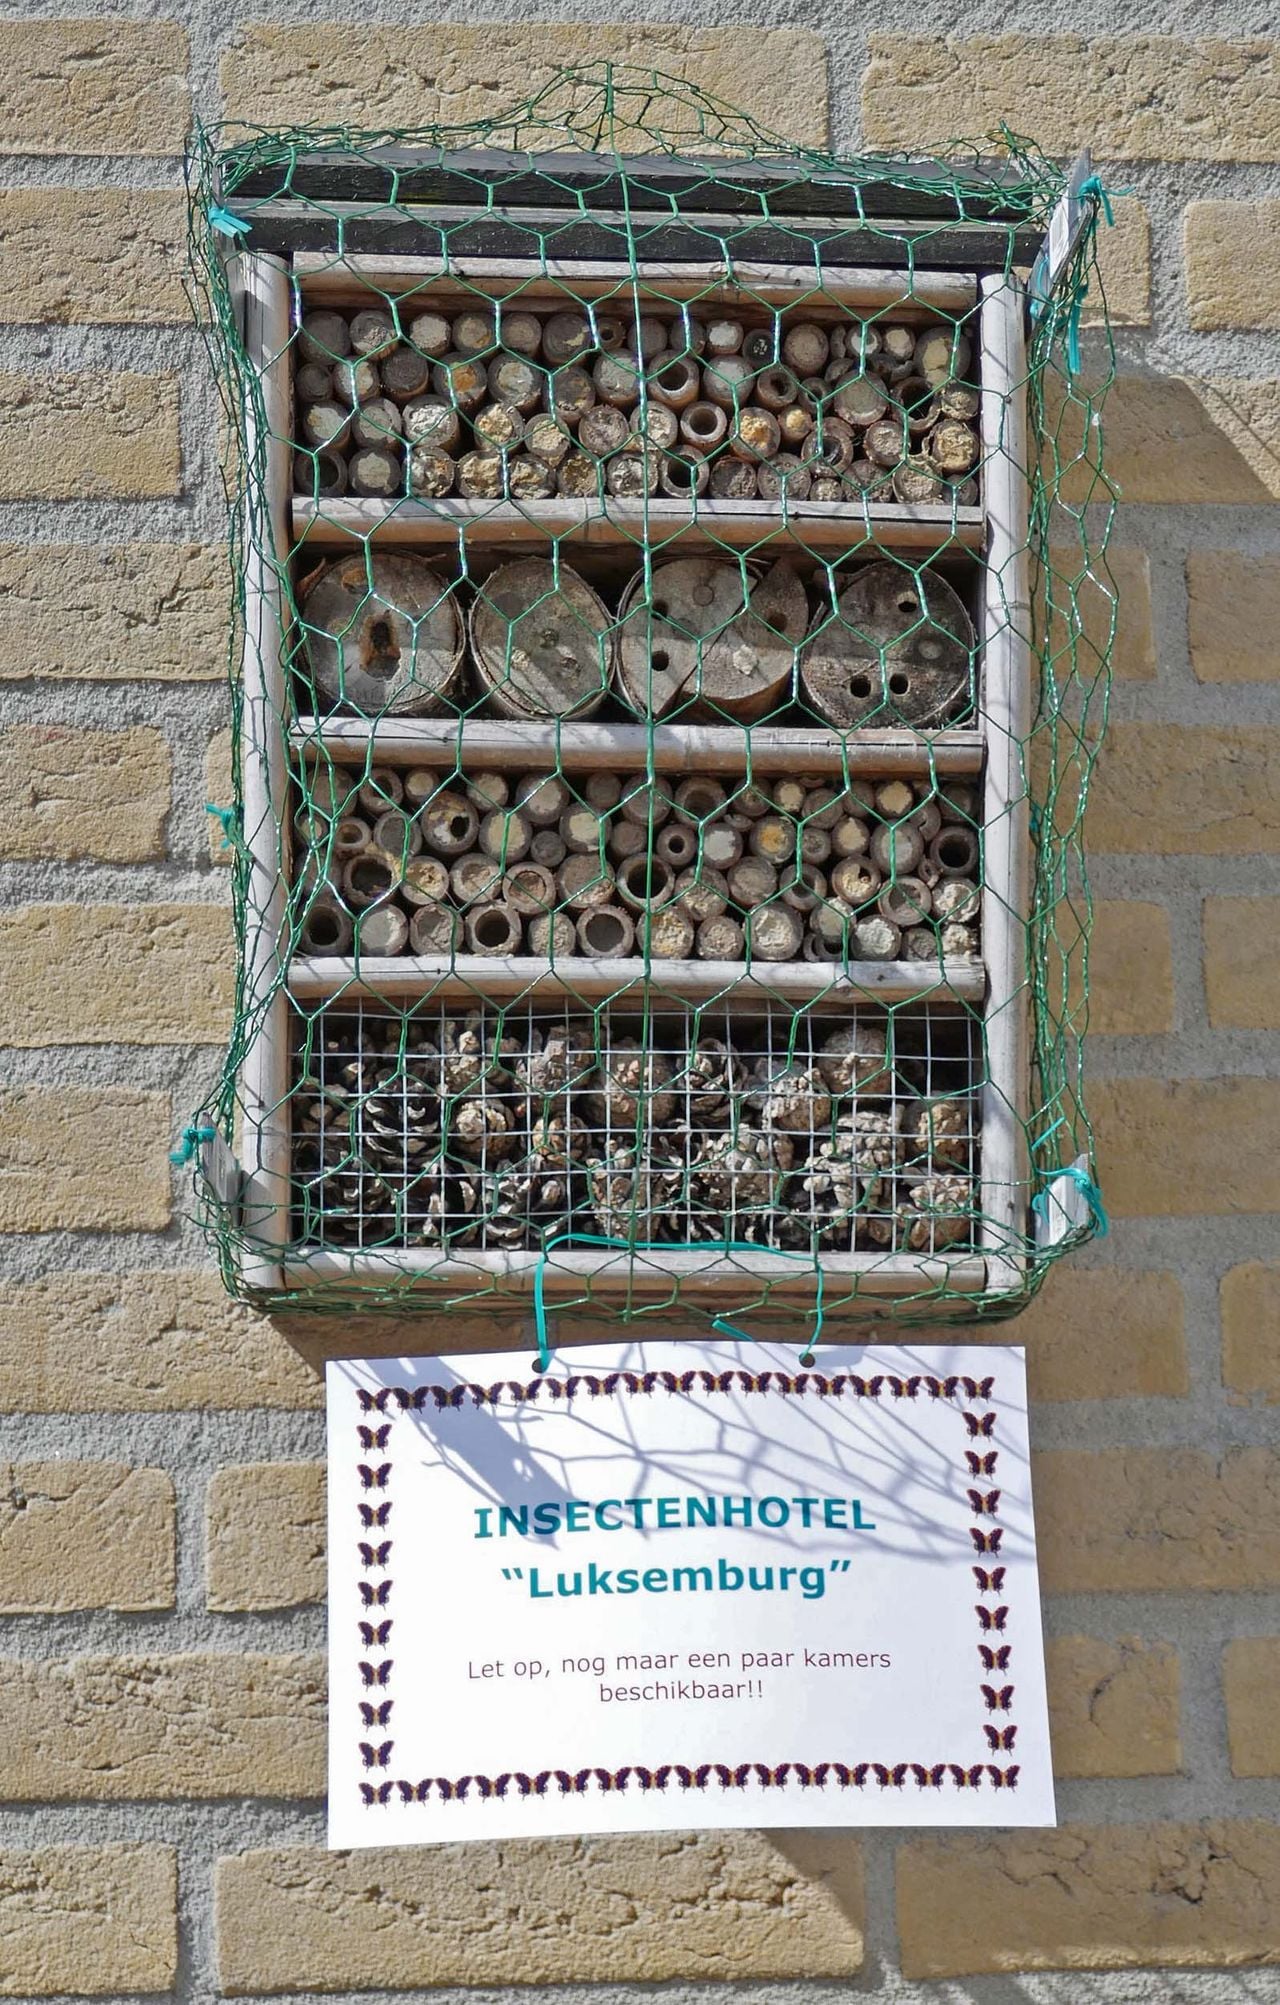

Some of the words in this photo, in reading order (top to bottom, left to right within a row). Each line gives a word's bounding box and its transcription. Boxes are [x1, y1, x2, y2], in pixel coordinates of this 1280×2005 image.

[474, 1496, 876, 1539] INSECTENHOTEL
[502, 1560, 851, 1599] “Luksemburg”
[468, 1659, 504, 1679] Let
[514, 1660, 550, 1680] op,
[562, 1655, 606, 1676] nog
[617, 1653, 678, 1672] maar
[688, 1652, 730, 1669] een
[741, 1649, 794, 1670] paar
[803, 1648, 891, 1668] kamers
[600, 1679, 763, 1703] beschikbaar!!
